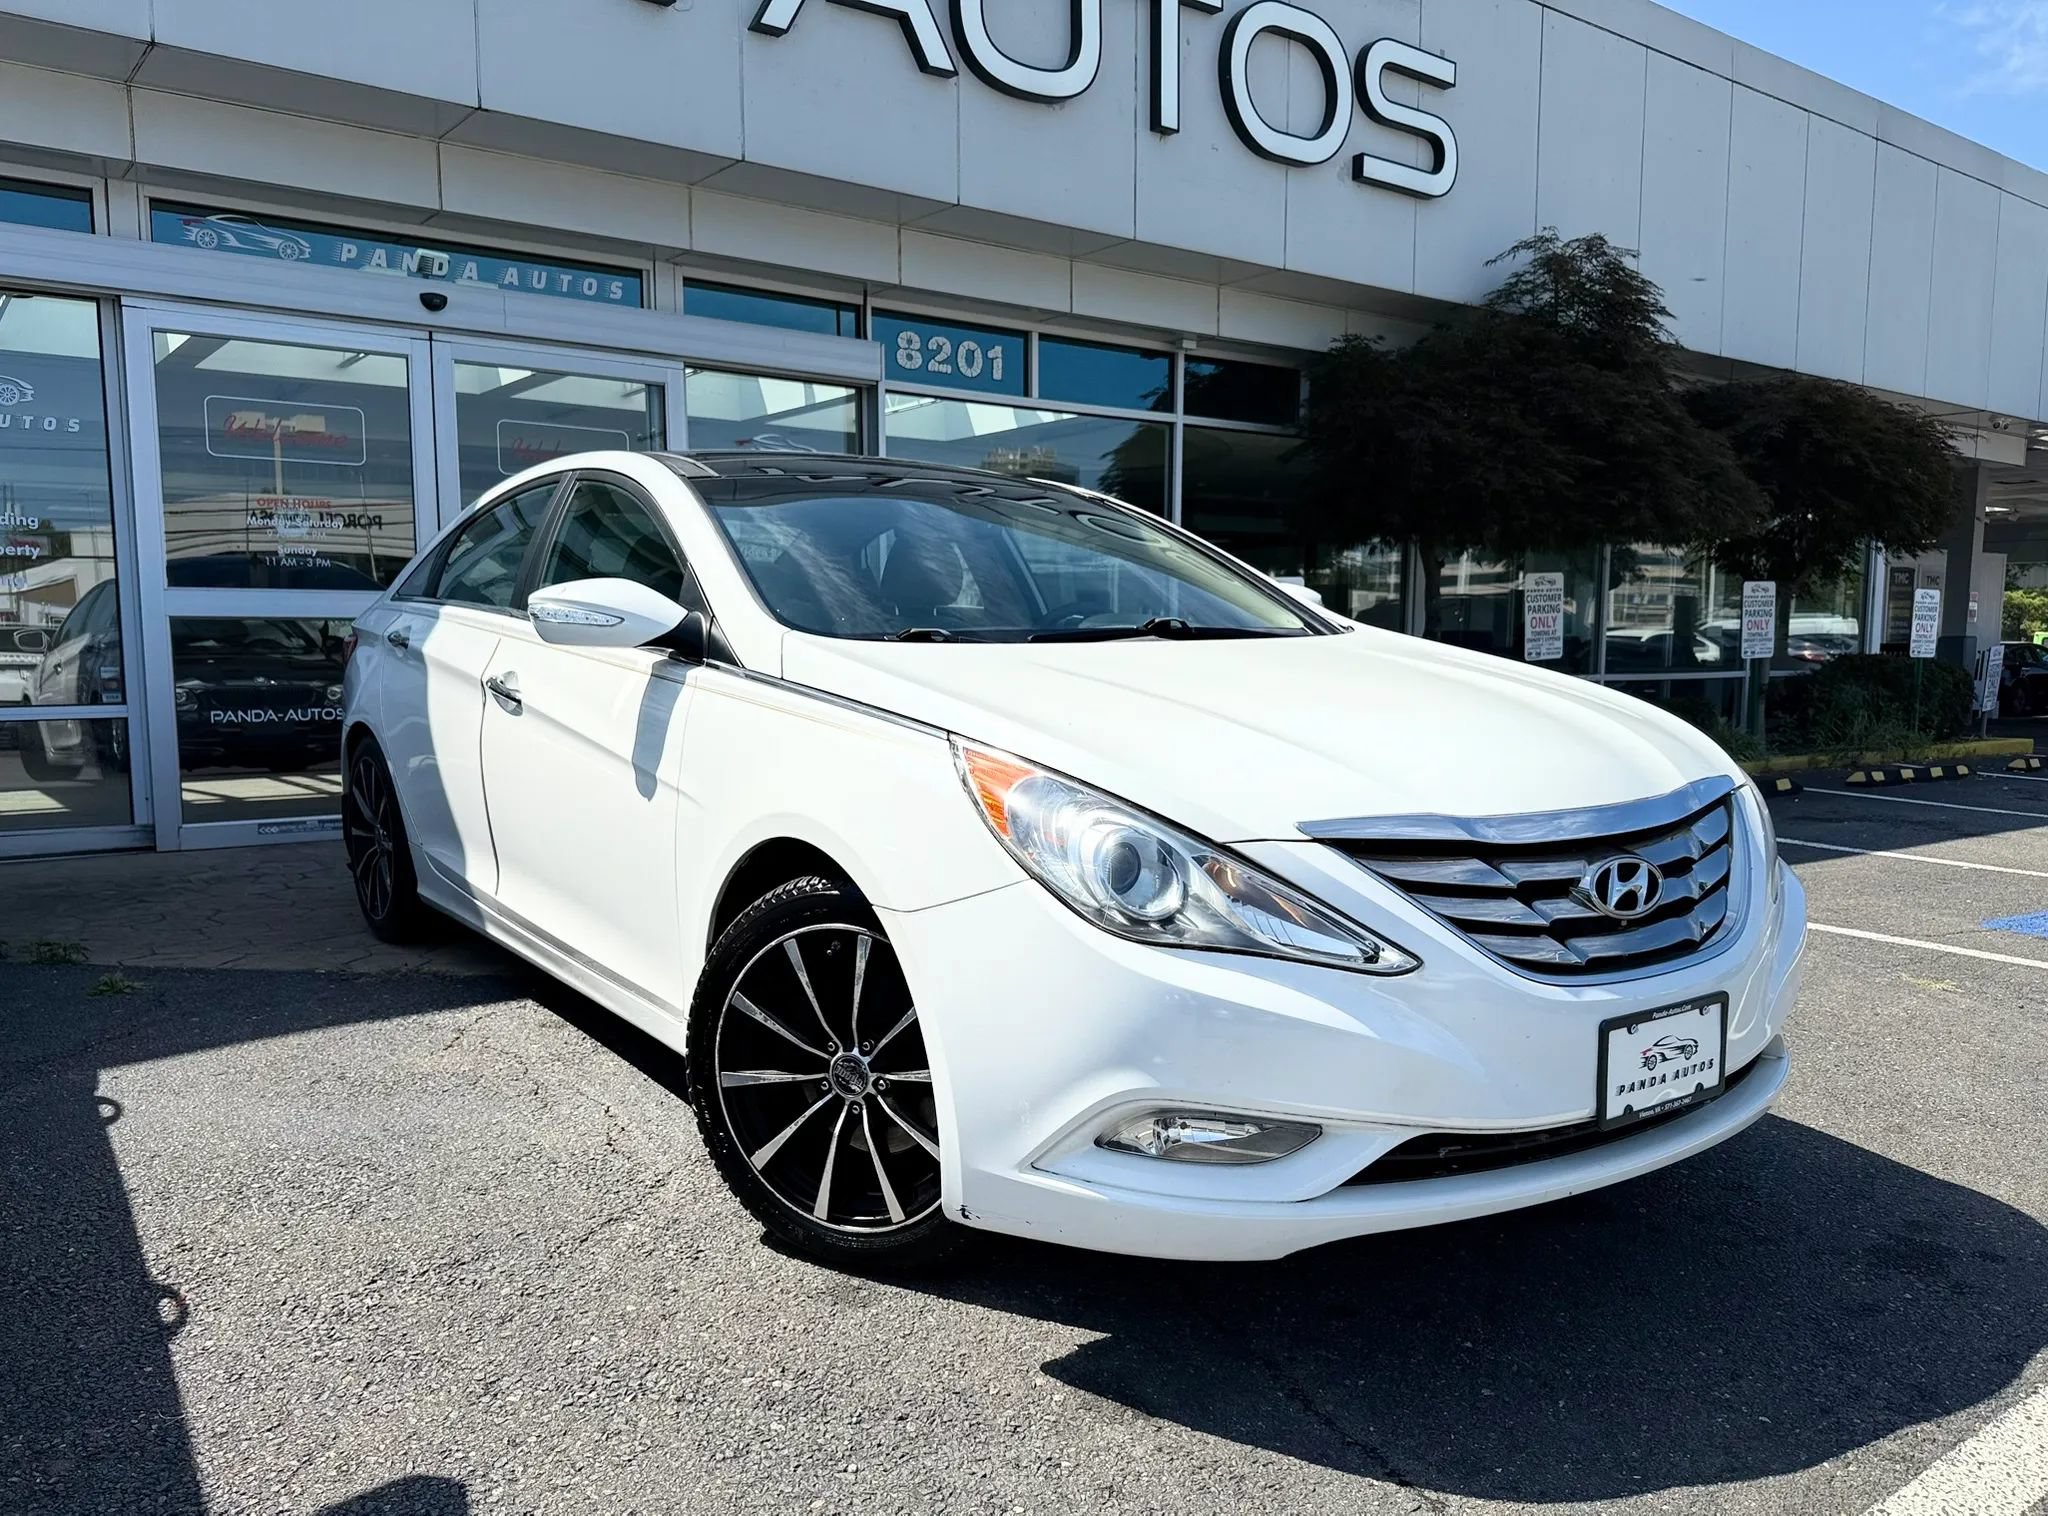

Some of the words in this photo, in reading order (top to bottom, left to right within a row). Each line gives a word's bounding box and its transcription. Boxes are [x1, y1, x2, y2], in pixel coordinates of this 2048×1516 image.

[337, 242, 479, 281] PANDA
[498, 266, 623, 299] AUTOS
[896, 331, 1003, 380] 8201
[256, 498, 289, 509] OPEN
[293, 498, 332, 510] HOURS
[277, 546, 318, 557] Sunday
[316, 559, 331, 568] PM
[1526, 593, 1562, 604] CUSTOMER
[1744, 600, 1774, 608] CUSTOMER
[1527, 603, 1561, 615] PARKING
[1744, 608, 1773, 618] PARKING
[1914, 605, 1938, 613] CUSTOMER
[1530, 615, 1558, 629] ONLY
[1914, 613, 1937, 622] PARKING
[1747, 619, 1770, 631] ONLY
[1915, 622, 1933, 633] ONLY
[210, 707, 344, 724] PANDA-AUTOS
[1616, 1074, 1666, 1095] PANDA
[1673, 1058, 1714, 1079] AUTOS
